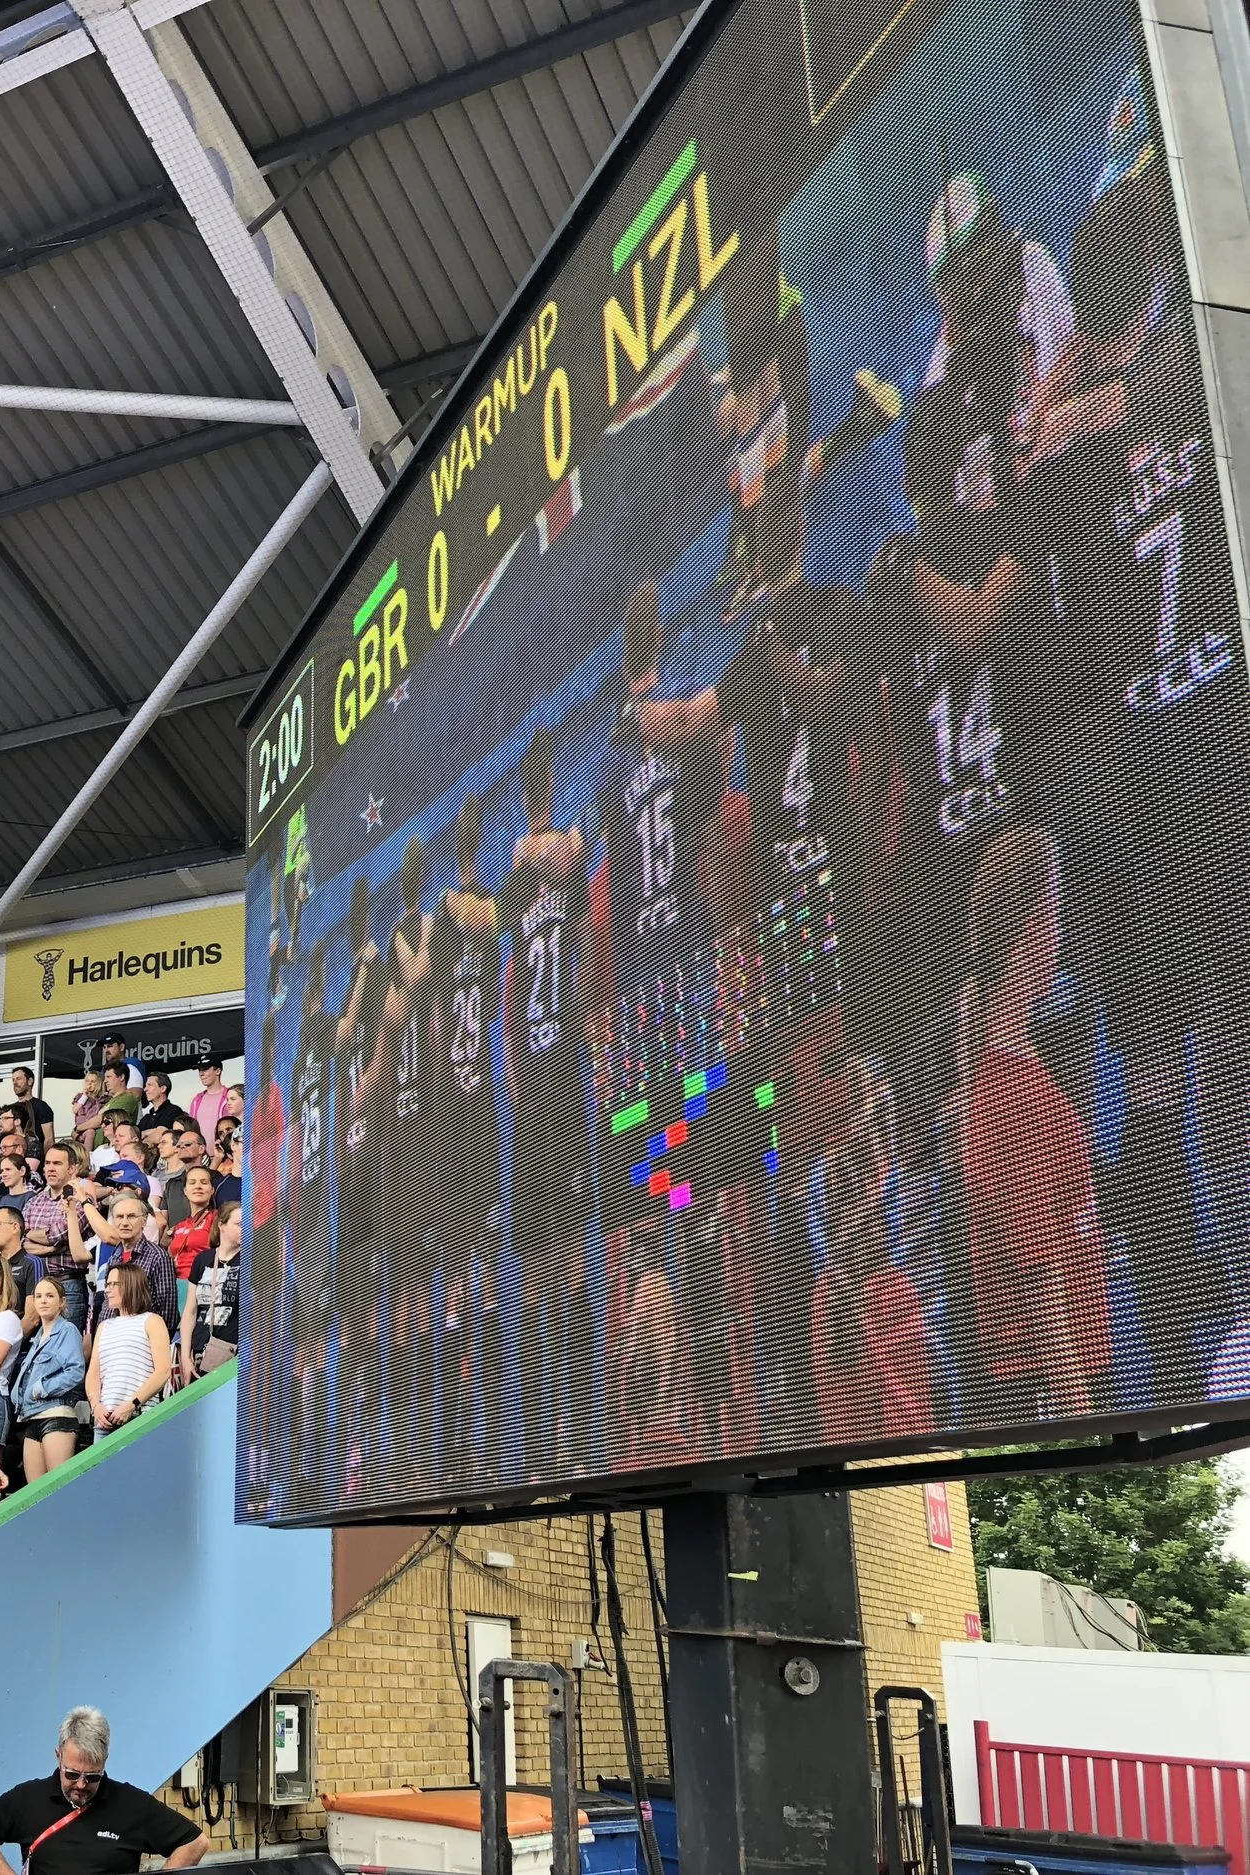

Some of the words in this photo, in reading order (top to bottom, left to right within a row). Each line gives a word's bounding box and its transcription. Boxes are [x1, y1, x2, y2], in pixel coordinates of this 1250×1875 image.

[333, 587, 408, 745] GBR
[426, 530, 448, 631] 0
[543, 368, 571, 481] 0
[602, 171, 741, 408] NZL
[430, 302, 558, 517] WARMUP
[1134, 510, 1184, 658] 7
[257, 693, 306, 813] 2:00
[782, 729, 815, 829] 4
[927, 665, 1002, 785] 14
[634, 790, 676, 899] 15
[68, 939, 223, 985] Harlequins
[527, 926, 562, 1023] 21
[102, 1035, 212, 1067] rlequins
